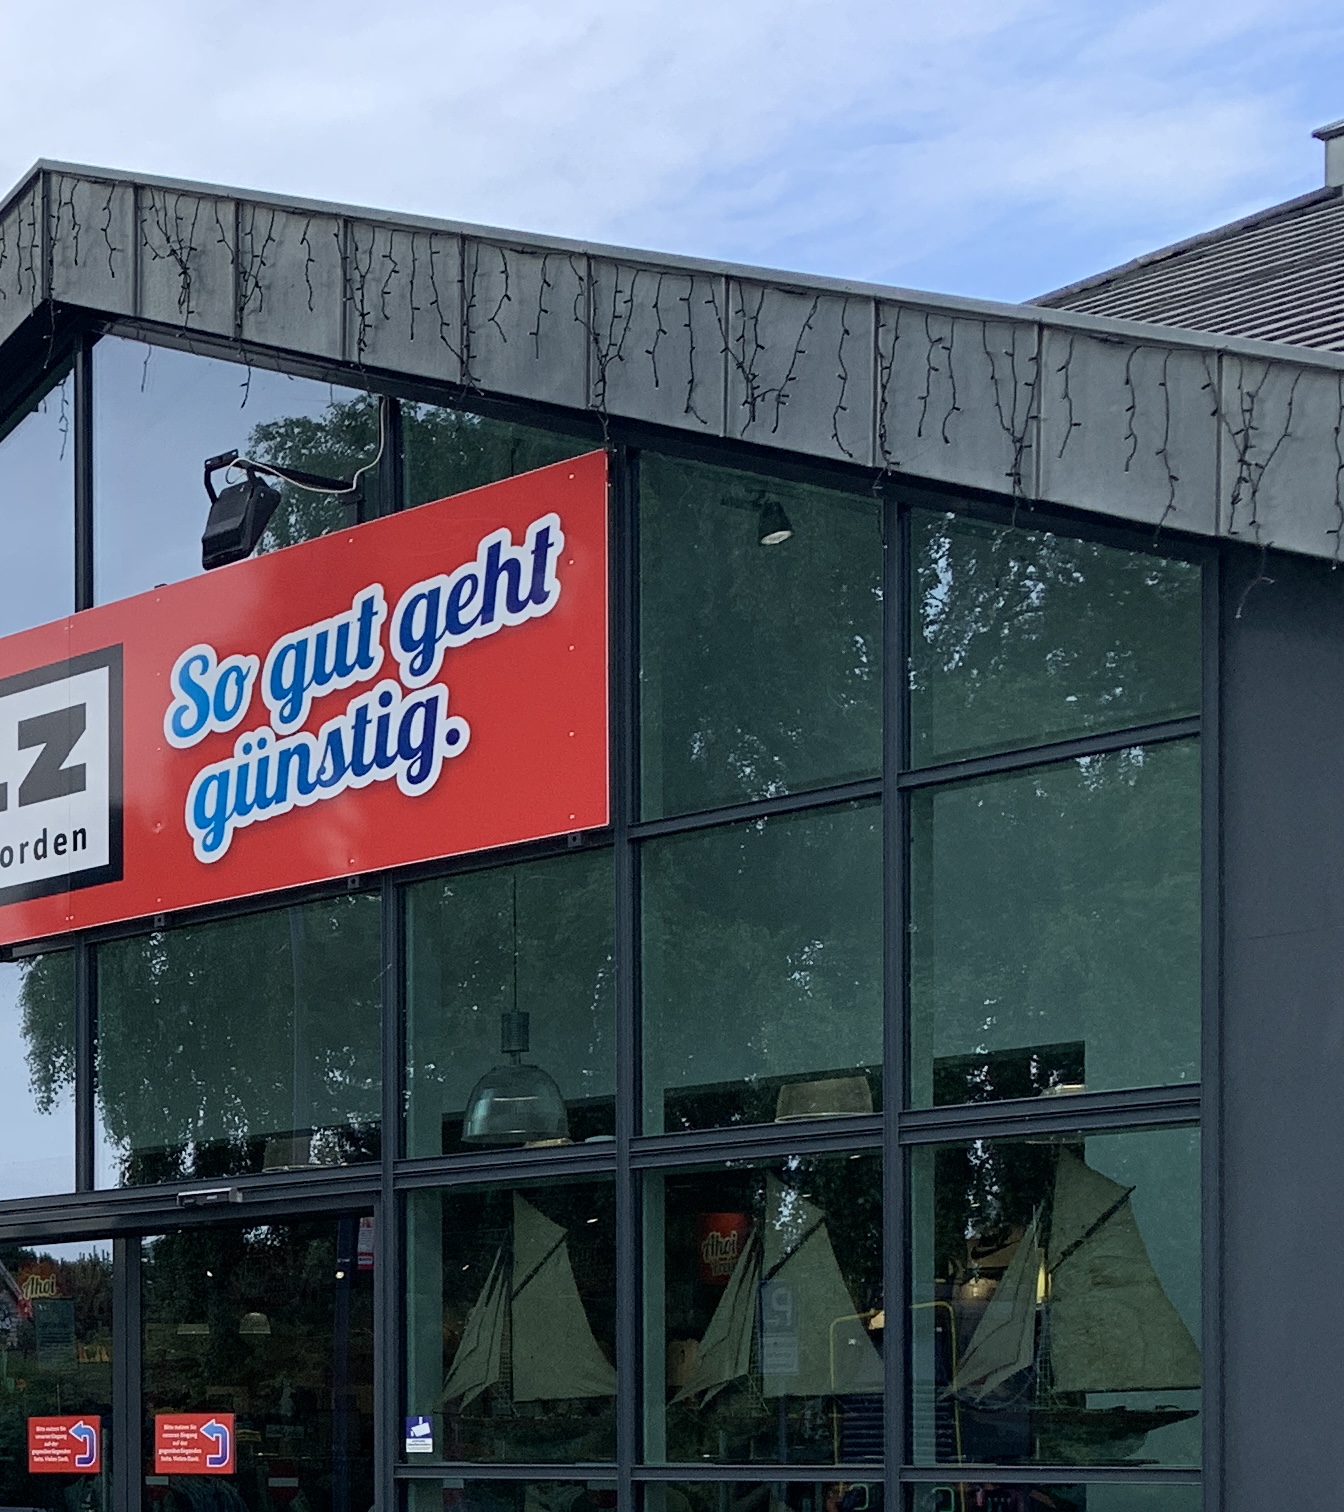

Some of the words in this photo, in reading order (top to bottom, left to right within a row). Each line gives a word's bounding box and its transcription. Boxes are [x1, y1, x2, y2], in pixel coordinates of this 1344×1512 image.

[168, 651, 253, 741] So
[266, 591, 381, 727] gut
[396, 523, 557, 680] geht
[189, 687, 463, 856] günstig.
